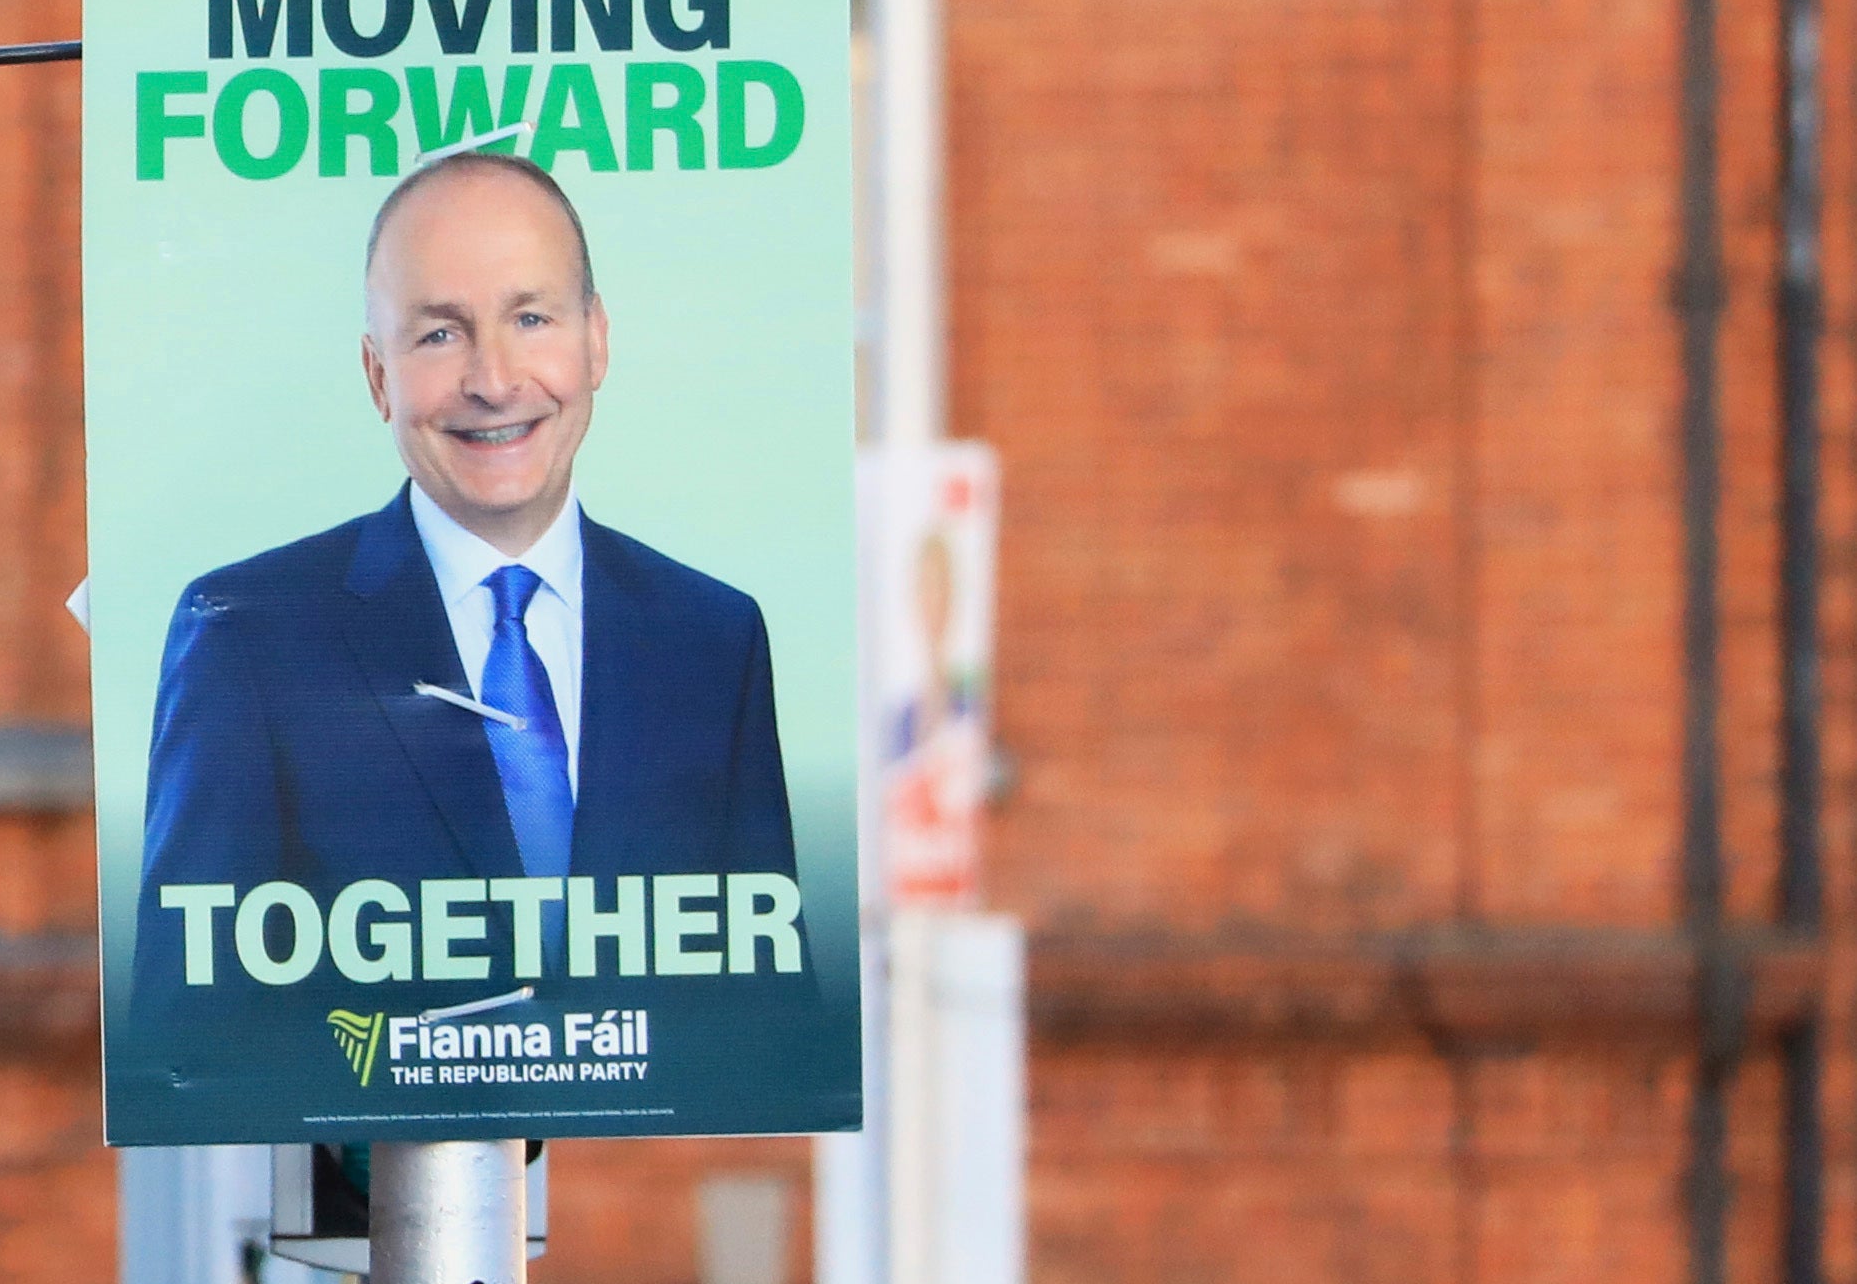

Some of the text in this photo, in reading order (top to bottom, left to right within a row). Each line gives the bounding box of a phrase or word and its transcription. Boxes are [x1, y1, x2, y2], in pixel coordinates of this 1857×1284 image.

[136, 59, 805, 182] FORWARD
[160, 873, 803, 986] TOGETHER
[389, 1009, 648, 1060] Fianna Fáil
[391, 1061, 648, 1085] THE REPUBLICAN PARTY
